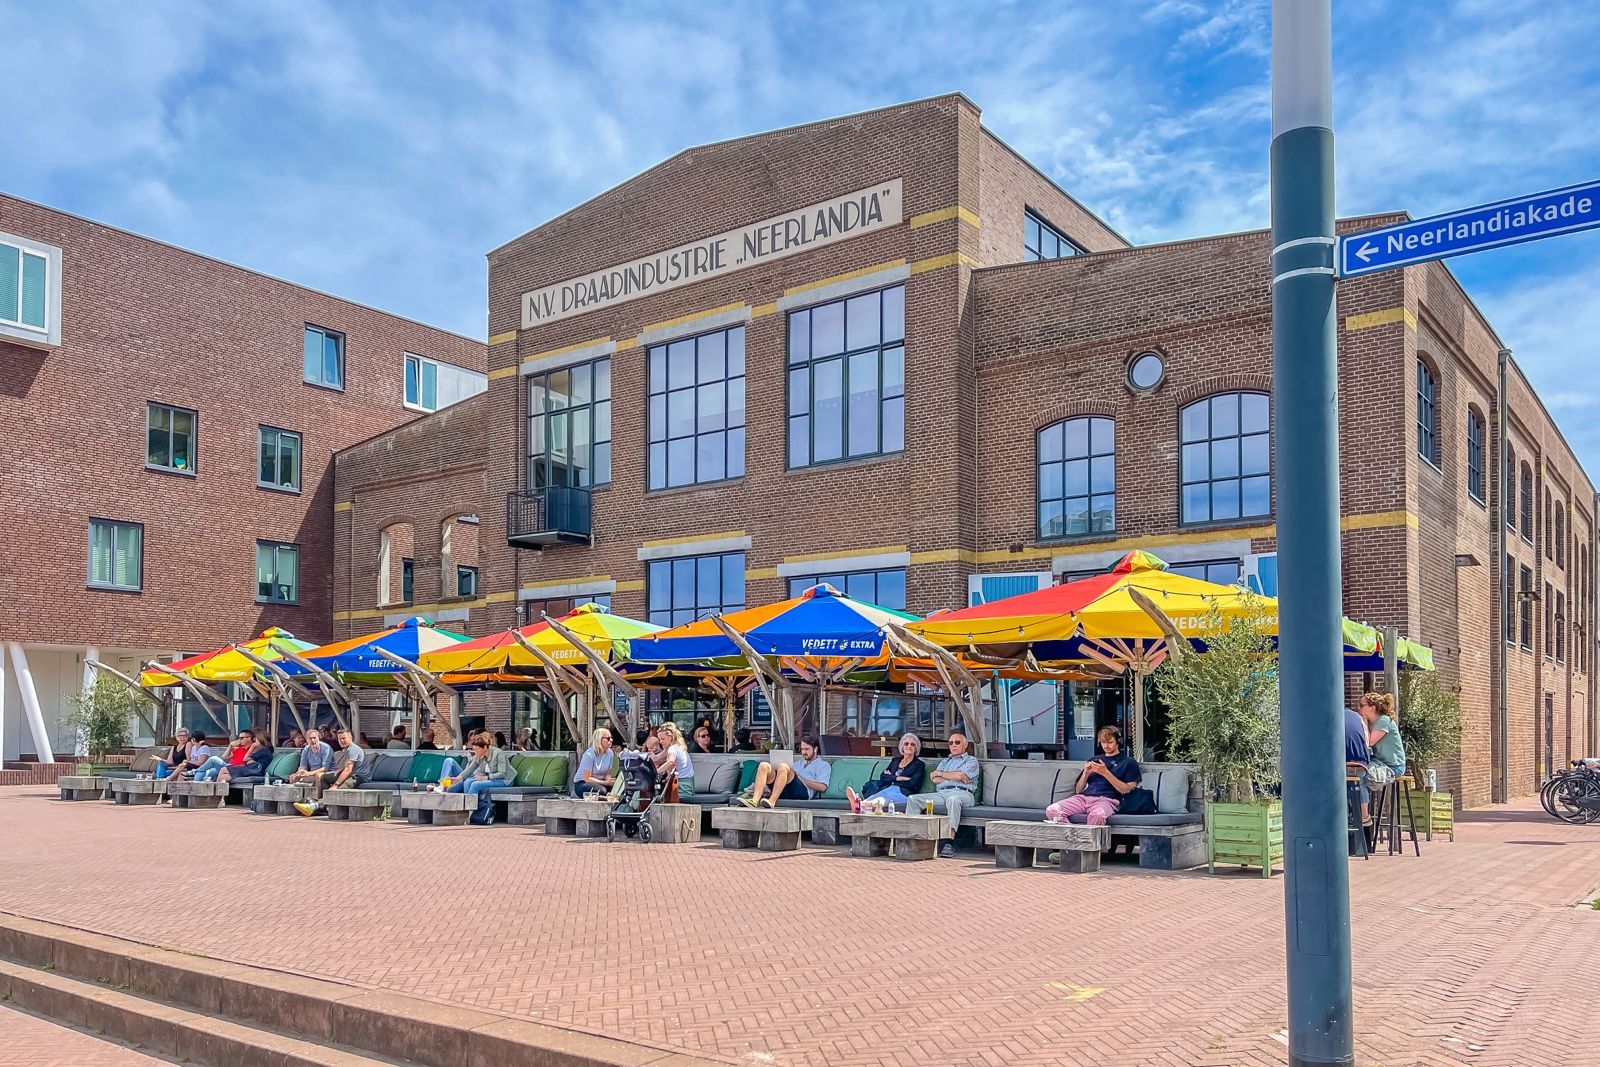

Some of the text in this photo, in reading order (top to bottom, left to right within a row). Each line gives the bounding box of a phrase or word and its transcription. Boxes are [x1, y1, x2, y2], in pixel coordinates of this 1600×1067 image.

[1387, 195, 1593, 254] Neerlandiakade
[529, 292, 556, 322] N.V.
[561, 238, 728, 312] DRAADINDUSTRIE
[551, 649, 578, 659] VEDETT
[802, 639, 875, 650] VEDETT EXTRA
